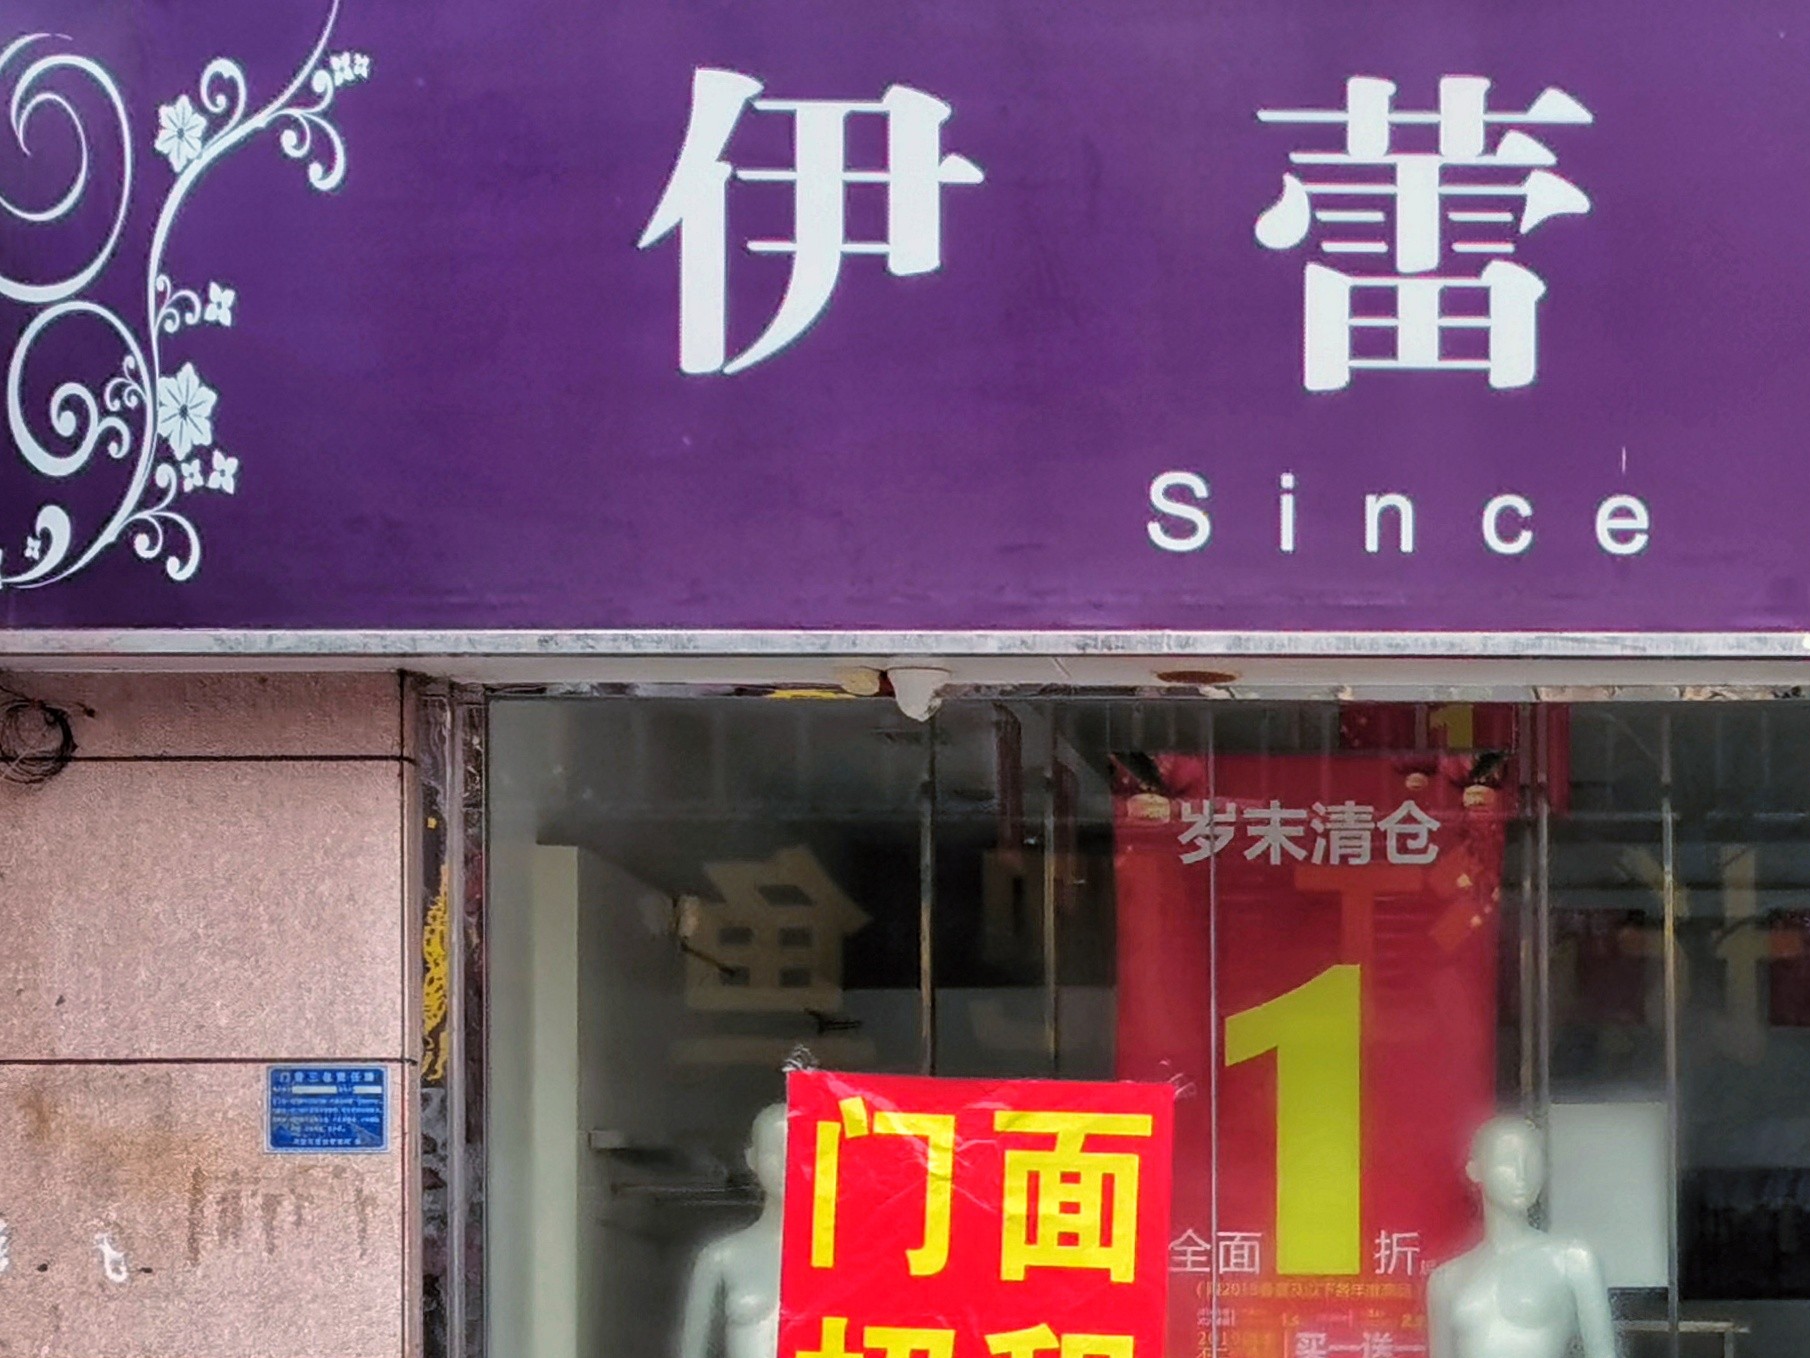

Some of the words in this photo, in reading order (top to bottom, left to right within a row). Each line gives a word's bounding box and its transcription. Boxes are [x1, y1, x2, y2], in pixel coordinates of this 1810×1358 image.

[1147, 471, 1650, 556] Since
[1176, 799, 1441, 865] 岁末清仓
[1168, 1228, 1262, 1276] 全面
[1225, 963, 1361, 1275] 1
[1373, 1229, 1421, 1276] 折
[810, 1096, 1153, 1284] 门面
